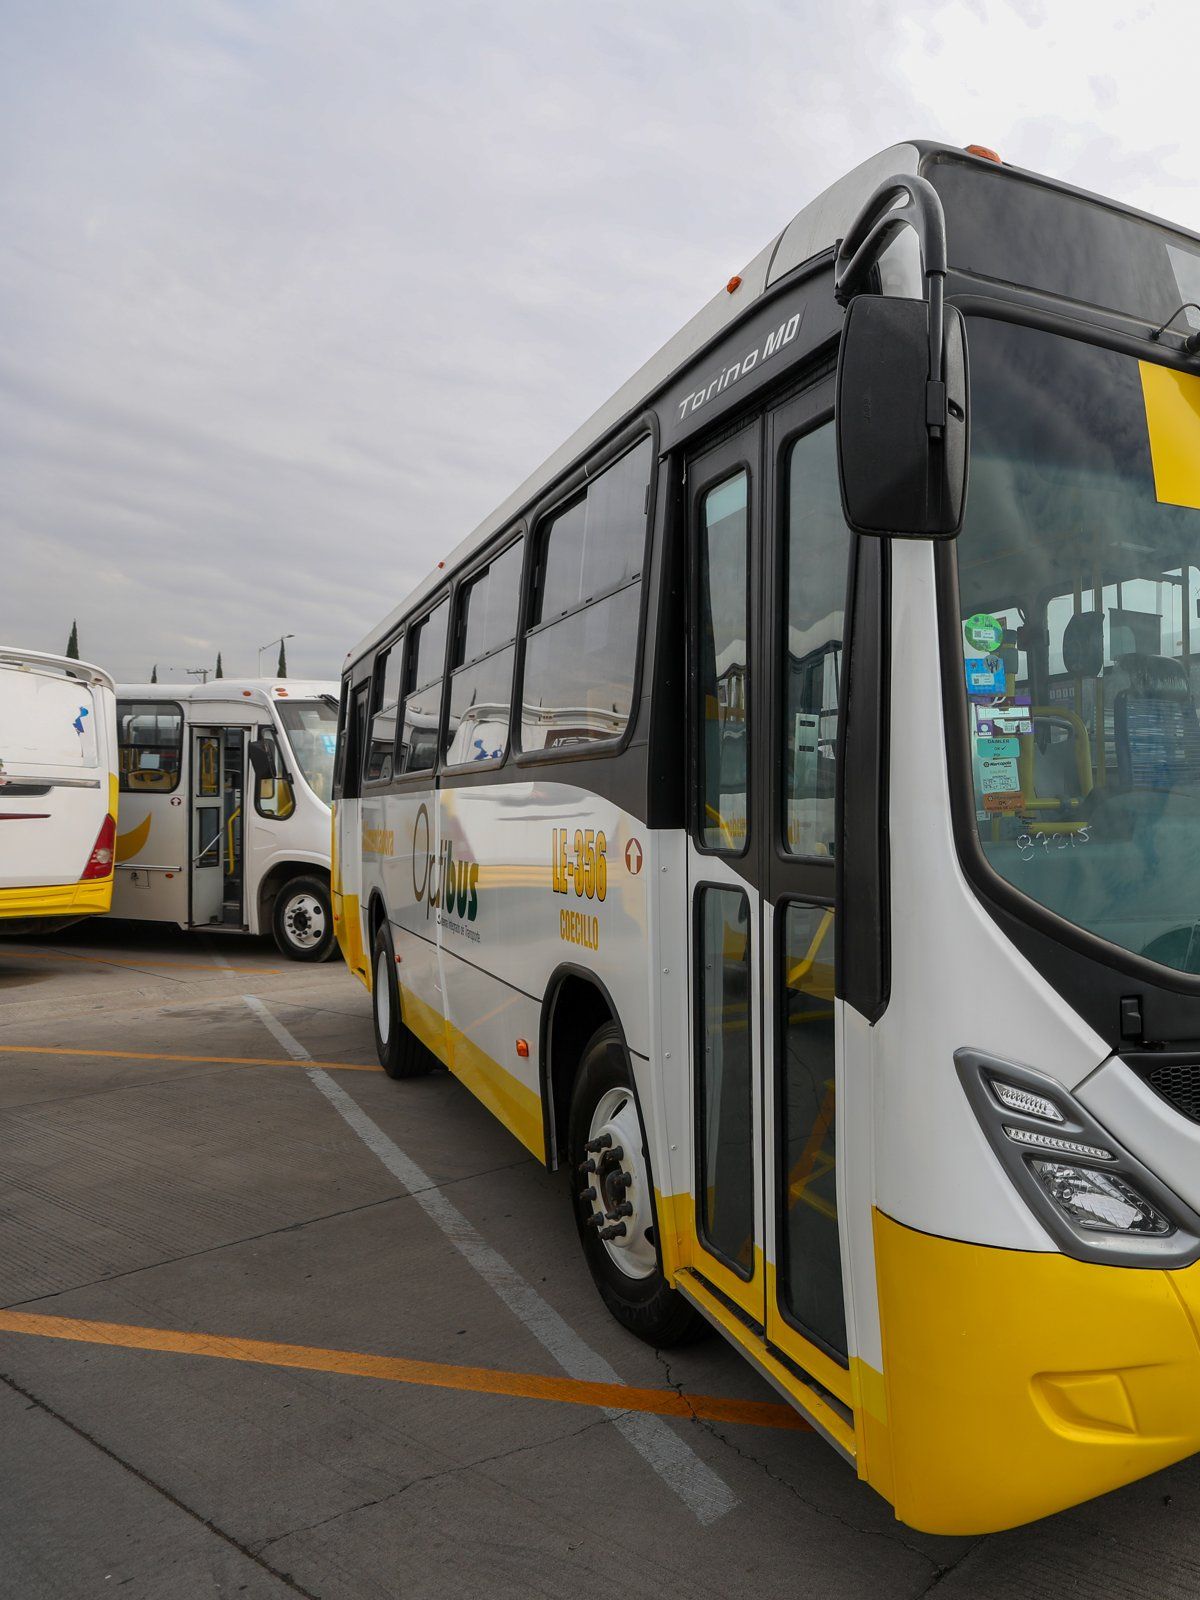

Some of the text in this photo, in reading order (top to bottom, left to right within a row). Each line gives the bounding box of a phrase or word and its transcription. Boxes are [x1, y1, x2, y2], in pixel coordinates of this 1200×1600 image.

[679, 313, 801, 420] Torino MD
[552, 828, 607, 902] LE-356
[560, 908, 599, 951] COECILLO
